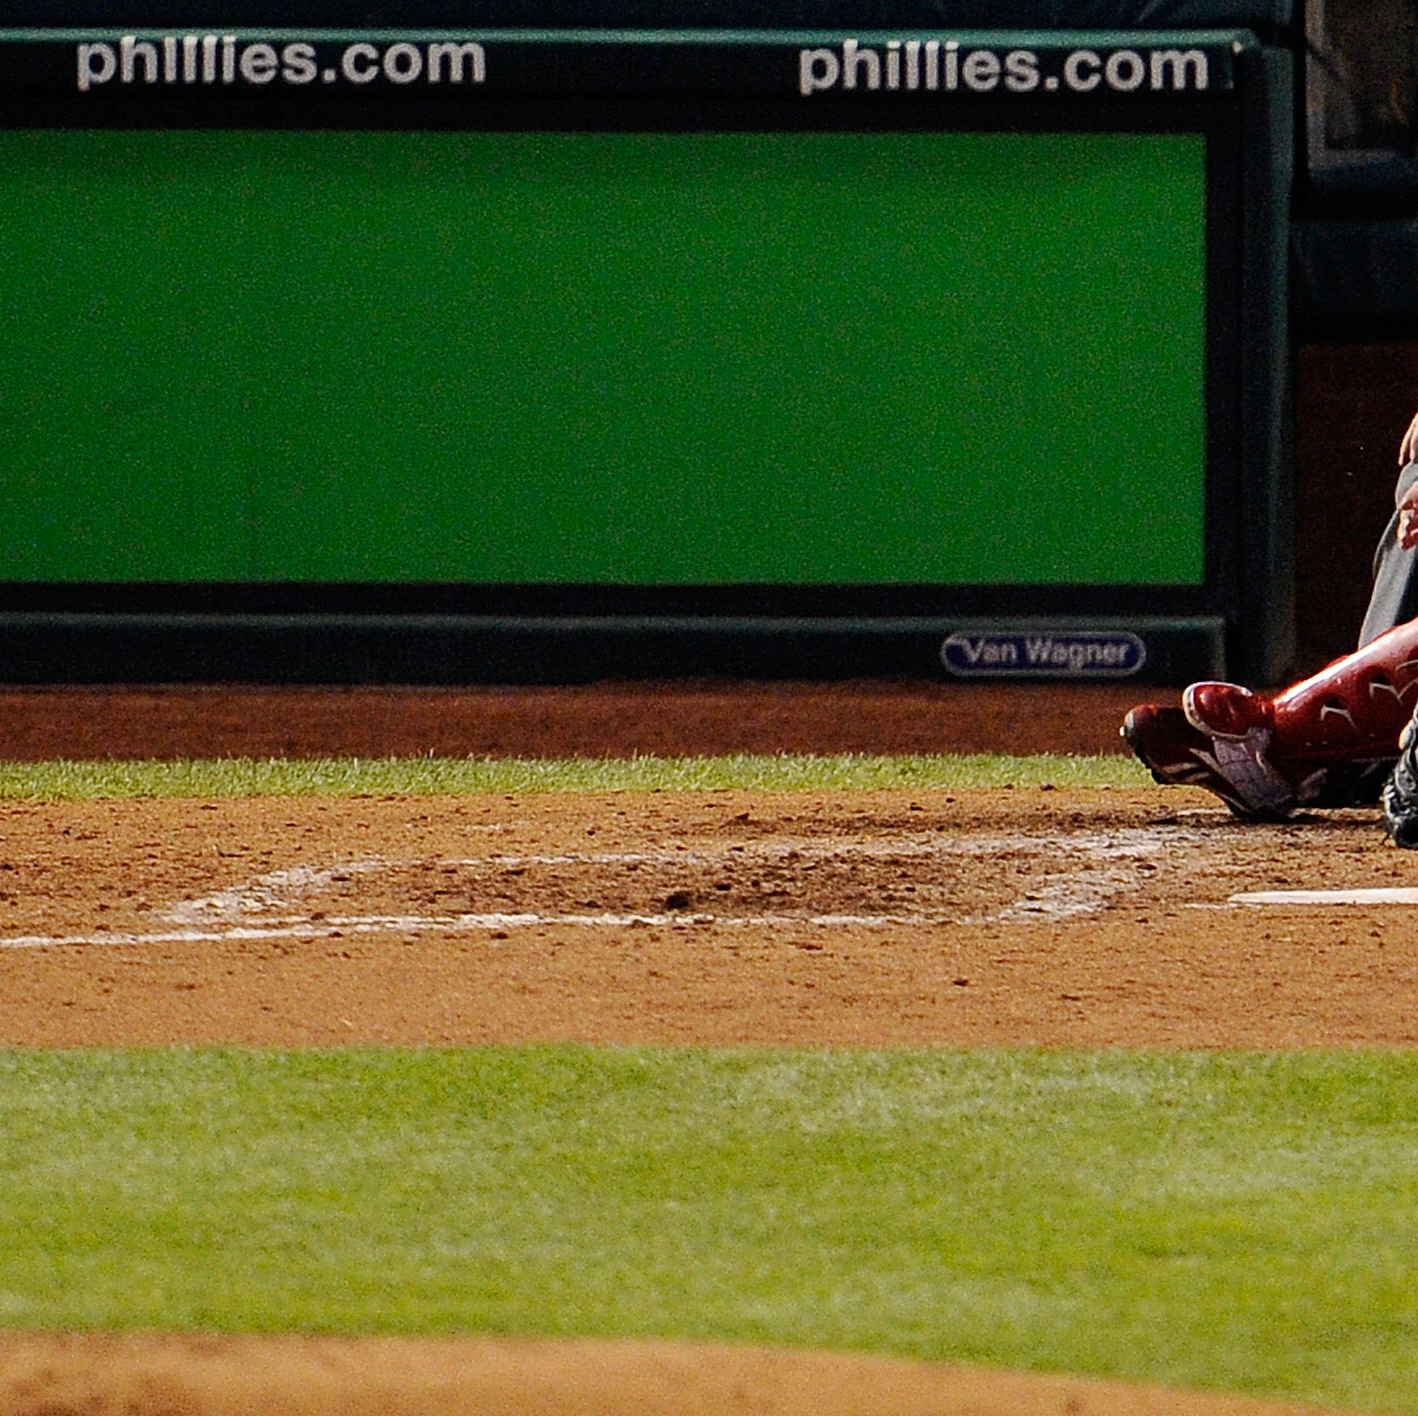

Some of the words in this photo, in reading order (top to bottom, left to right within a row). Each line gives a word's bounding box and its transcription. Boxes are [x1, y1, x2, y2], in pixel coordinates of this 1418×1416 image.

[77, 35, 487, 92] phillies.com
[799, 38, 1210, 97] phillies.com
[960, 637, 1019, 665] Van
[1024, 637, 1131, 673] Wagner
